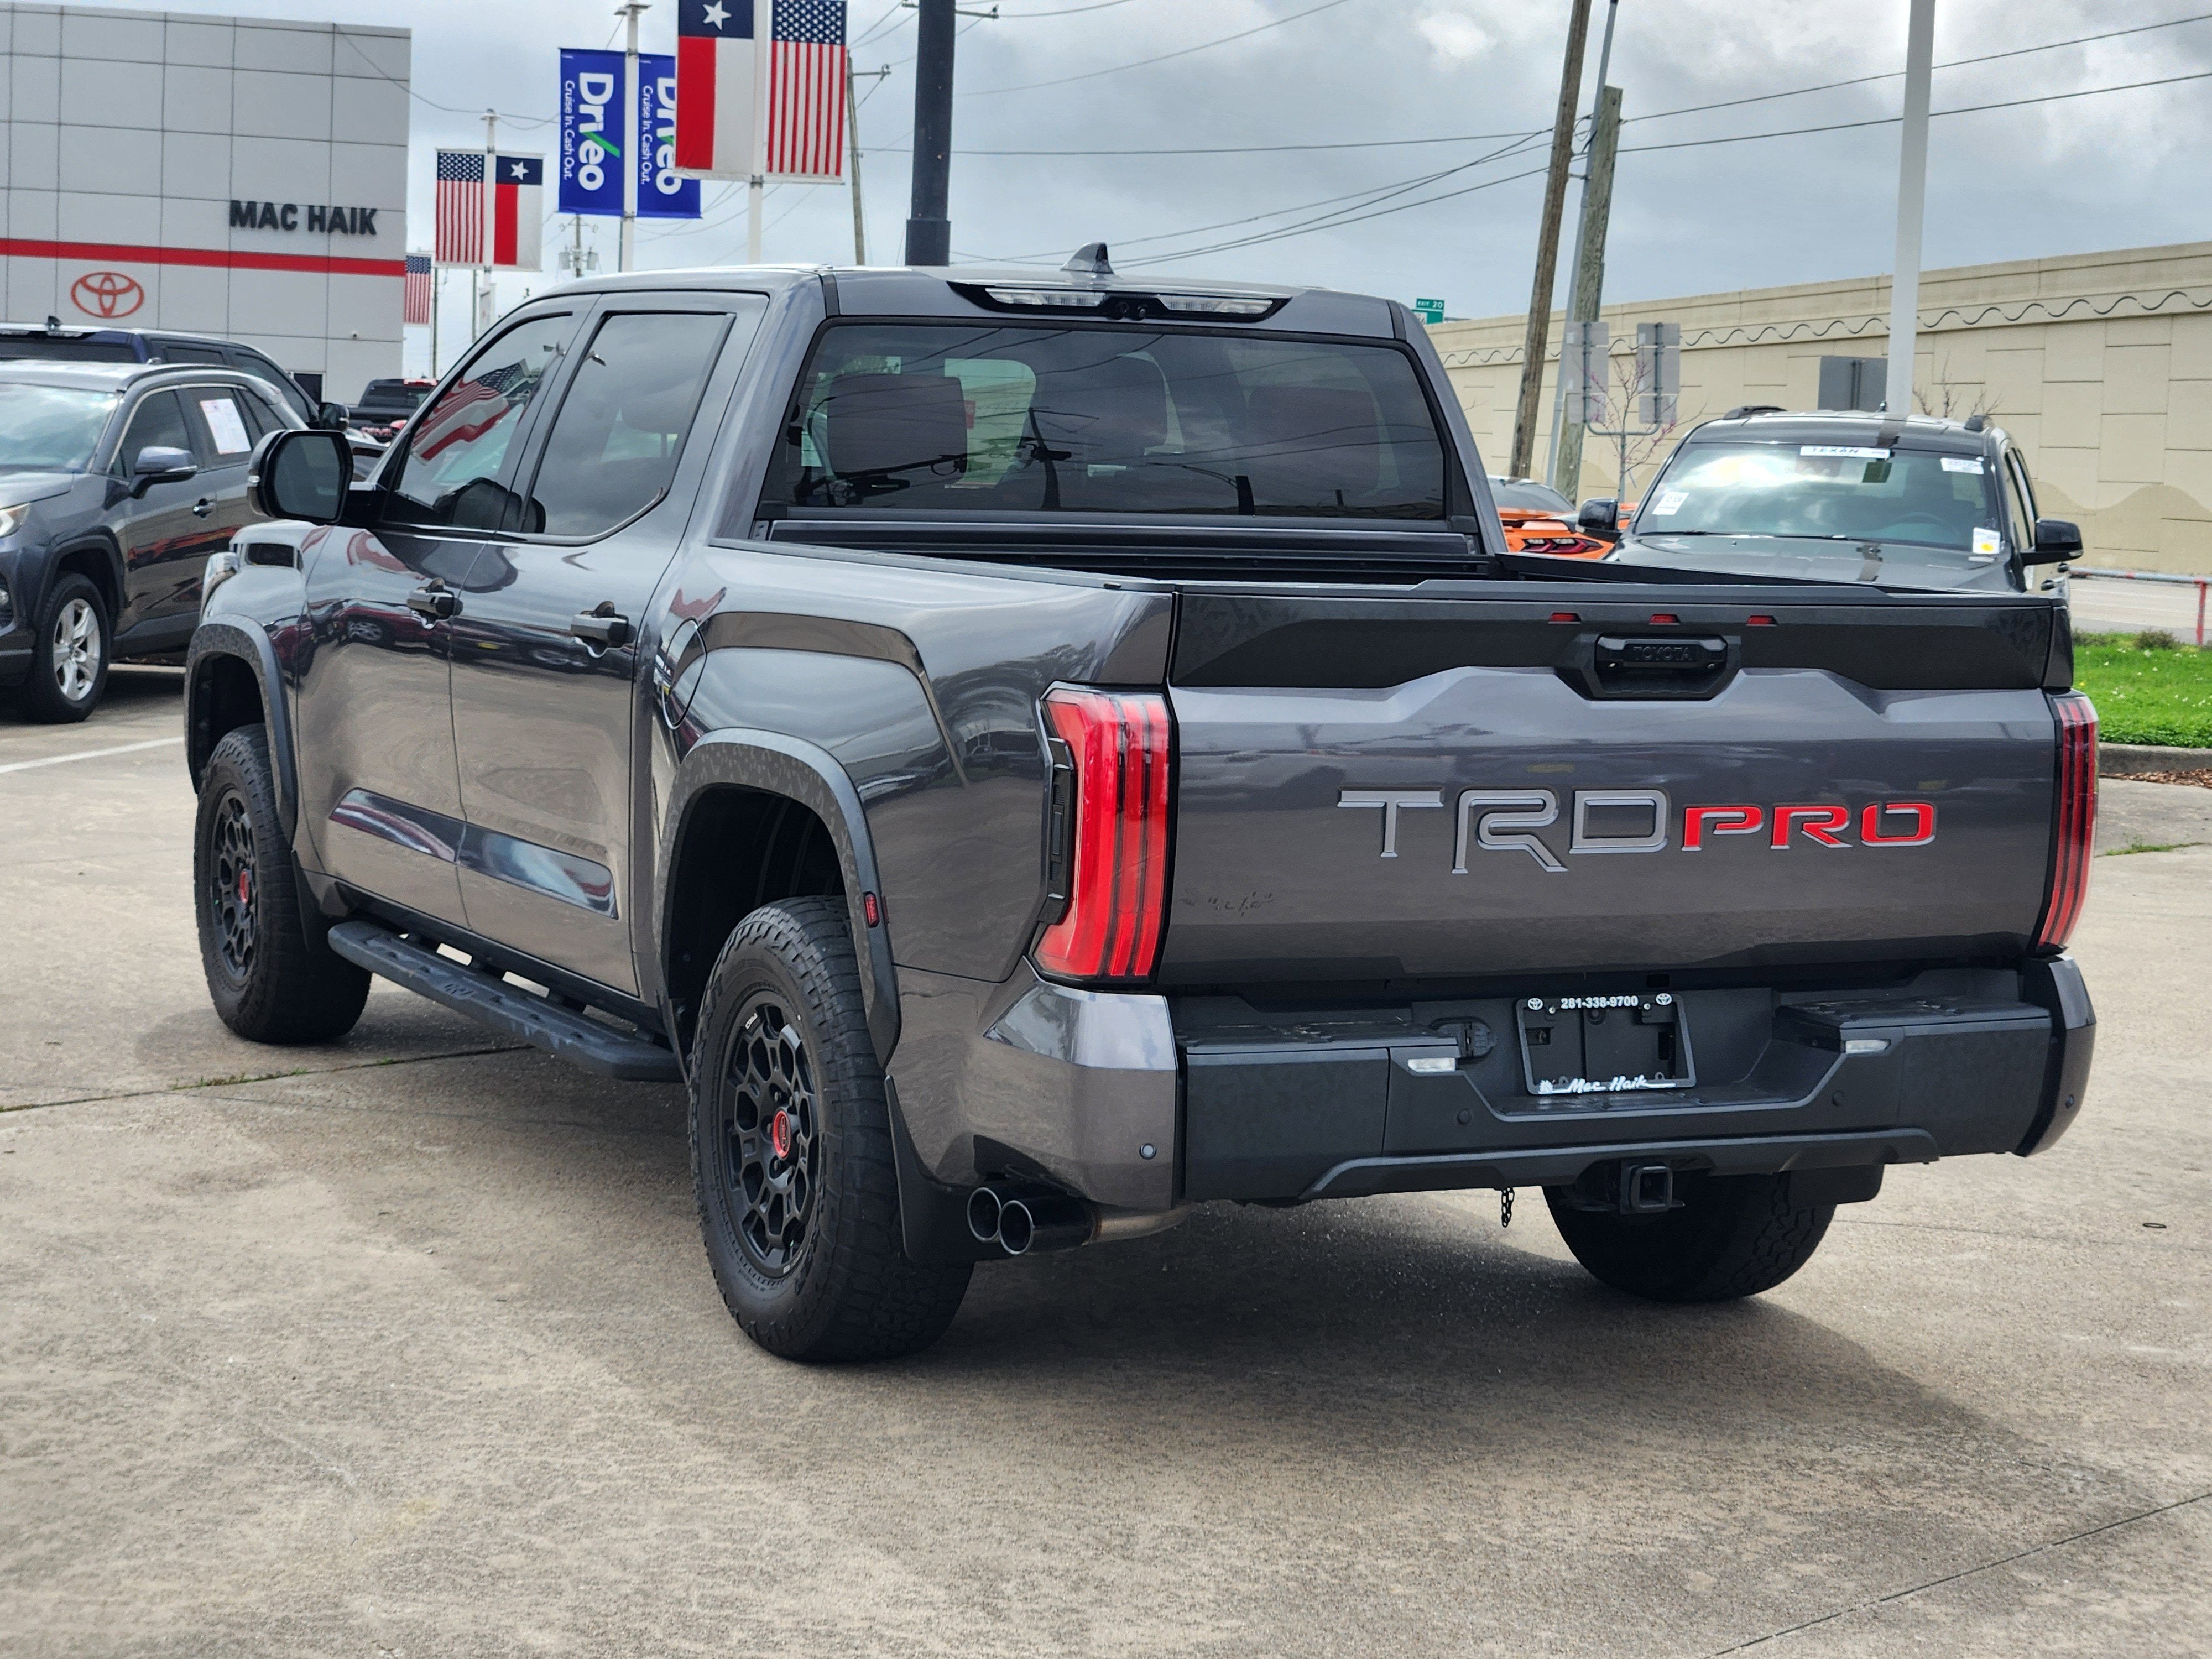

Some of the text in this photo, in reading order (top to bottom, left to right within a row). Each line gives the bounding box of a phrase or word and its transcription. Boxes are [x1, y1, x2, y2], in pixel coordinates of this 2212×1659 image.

[564, 80, 575, 114] Cruise
[641, 85, 653, 119] Cruise
[564, 129, 575, 155] Cash
[641, 134, 653, 160] Cash
[229, 200, 377, 236] MAC HAIK
[1432, 300, 1443, 309] 20
[1633, 646, 1693, 661] TOYOTA
[1337, 788, 1936, 874] TRD PRO
[1560, 995, 1639, 1010] 281-338-9700
[1569, 1074, 1649, 1094] Mac Haik
